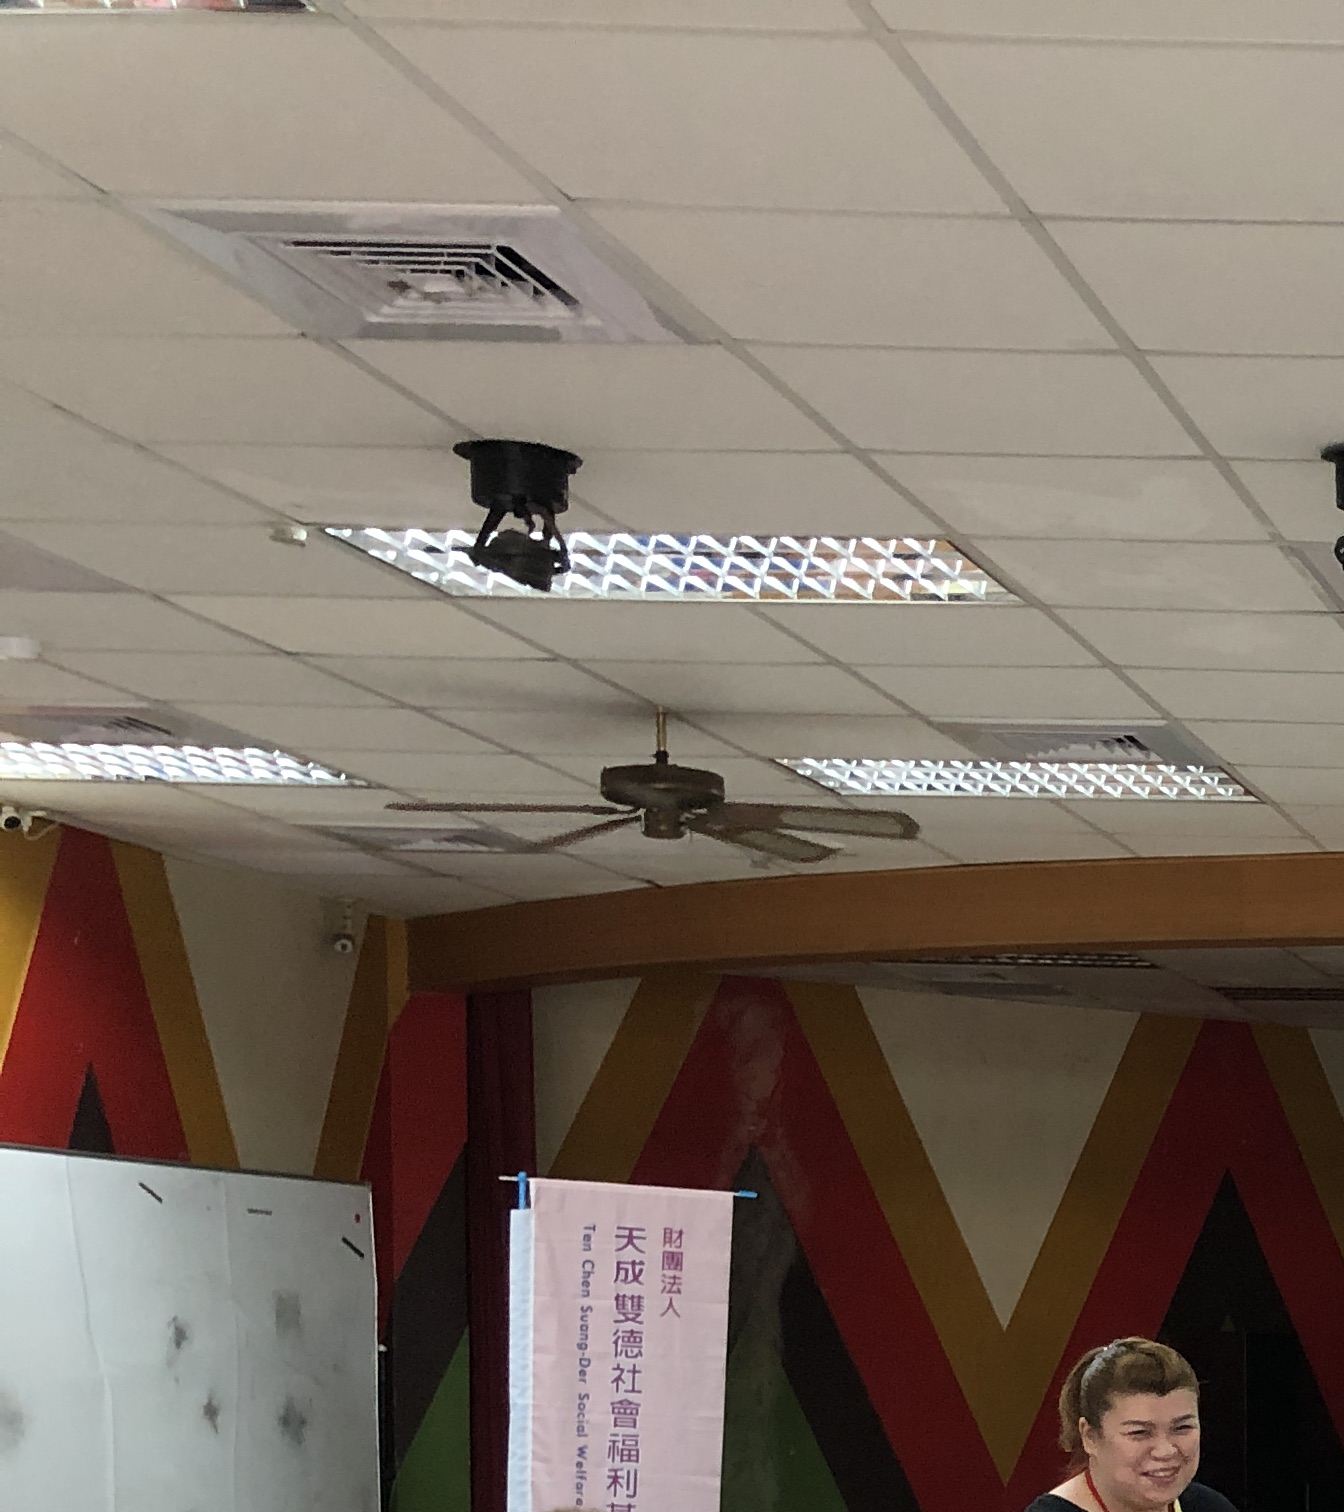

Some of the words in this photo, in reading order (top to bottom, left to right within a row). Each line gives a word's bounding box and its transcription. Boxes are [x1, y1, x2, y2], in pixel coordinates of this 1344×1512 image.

[582, 1224, 596, 1252] Ten
[581, 1260, 595, 1298] Chen
[660, 1226, 684, 1319] 財團法人
[577, 1305, 593, 1384] Suang-Der
[577, 1393, 591, 1438] Social
[575, 1446, 588, 1507] Welfare
